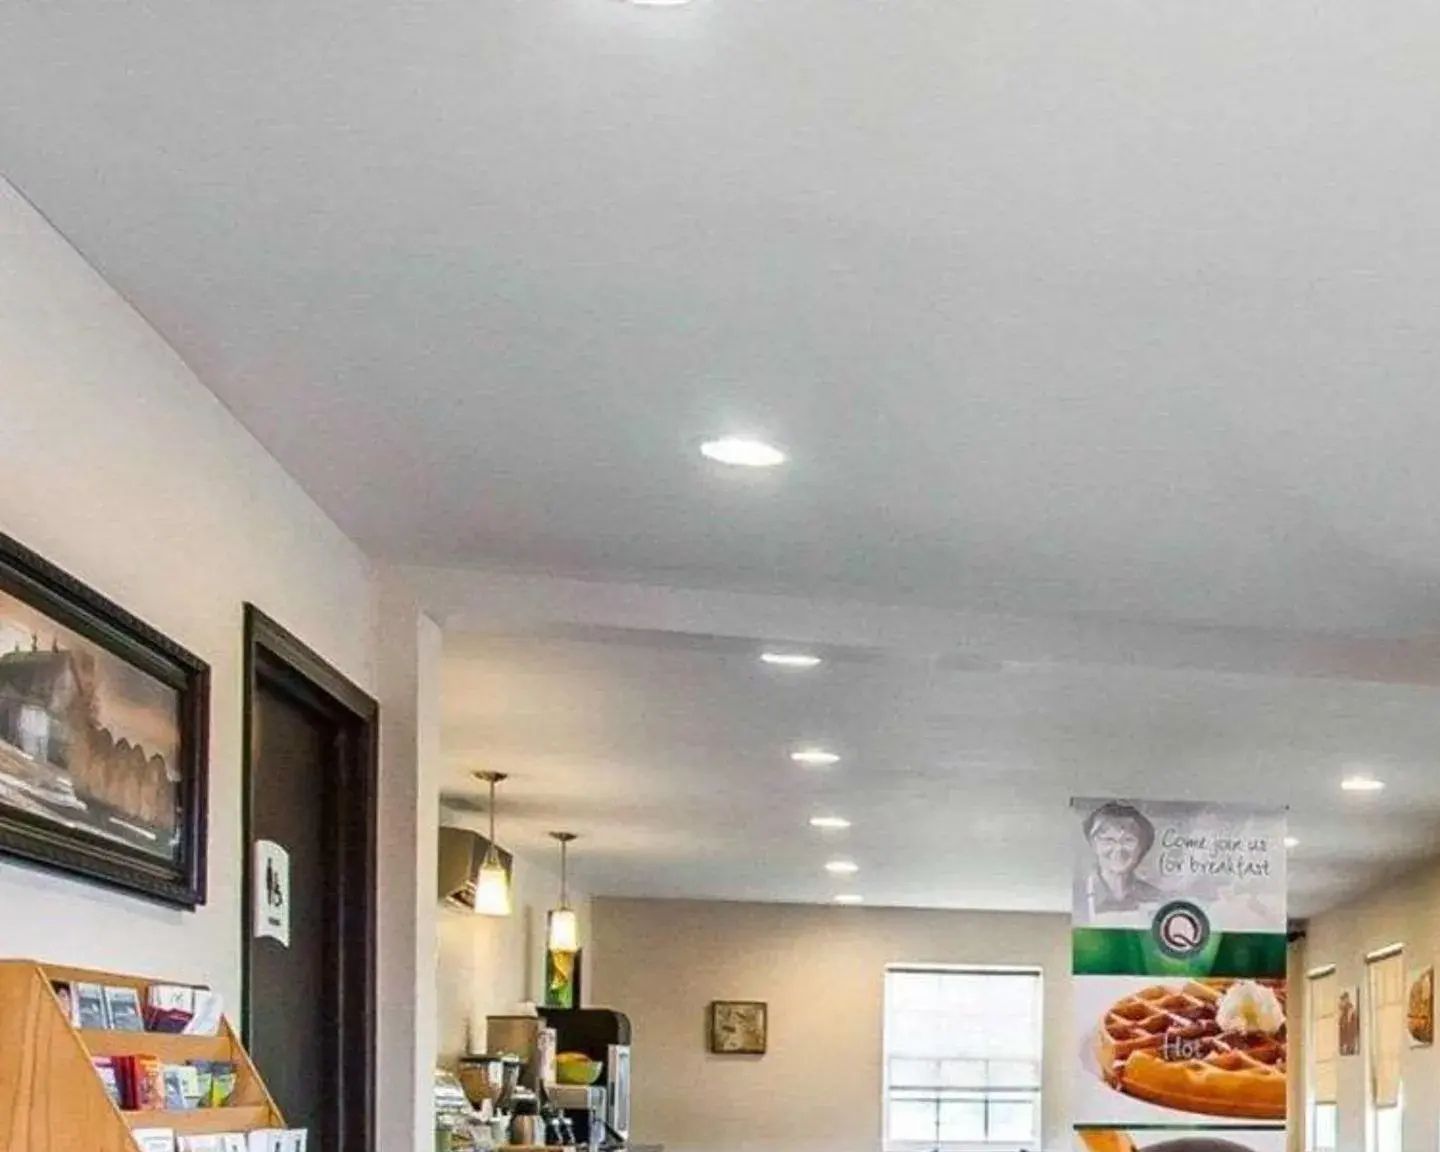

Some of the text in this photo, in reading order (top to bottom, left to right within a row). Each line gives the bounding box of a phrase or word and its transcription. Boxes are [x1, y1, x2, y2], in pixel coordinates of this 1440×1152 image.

[1161, 828, 1206, 849] Come
[1246, 838, 1267, 852] us
[1159, 852, 1270, 879] for breakfast
[1163, 912, 1201, 949] Q
[1161, 1032, 1203, 1061] Hot
